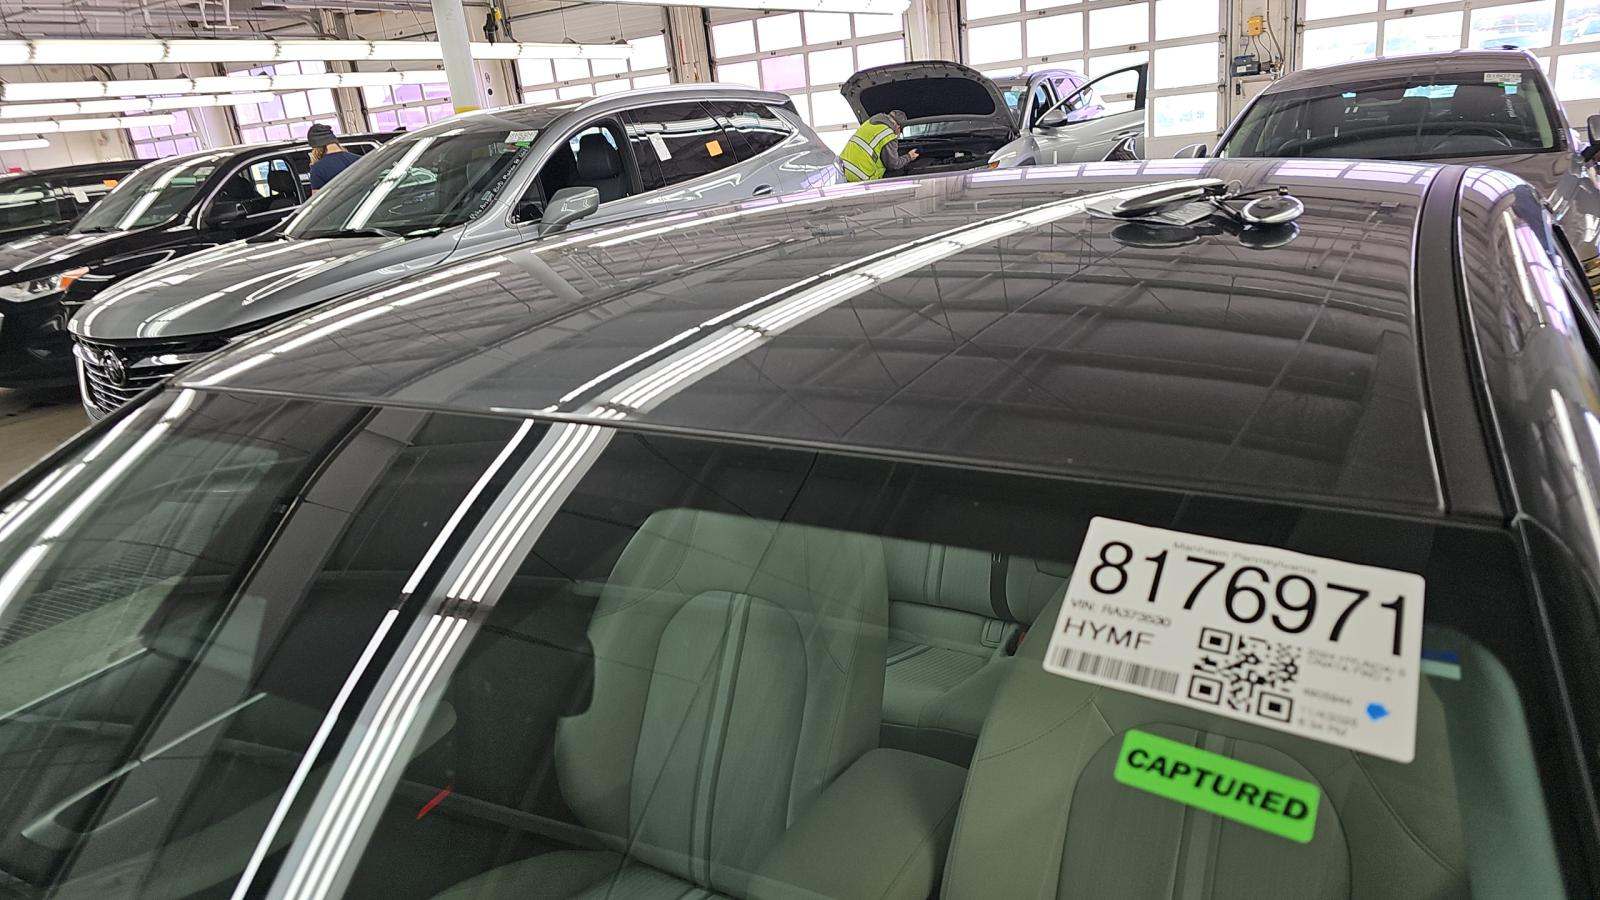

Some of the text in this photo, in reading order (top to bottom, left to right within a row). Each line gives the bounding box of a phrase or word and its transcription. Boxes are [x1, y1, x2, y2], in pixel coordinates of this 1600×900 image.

[1063, 616, 1156, 651] HYMF
[1090, 541, 1405, 656] 8176971
[1127, 748, 1310, 821] CAPTURED
